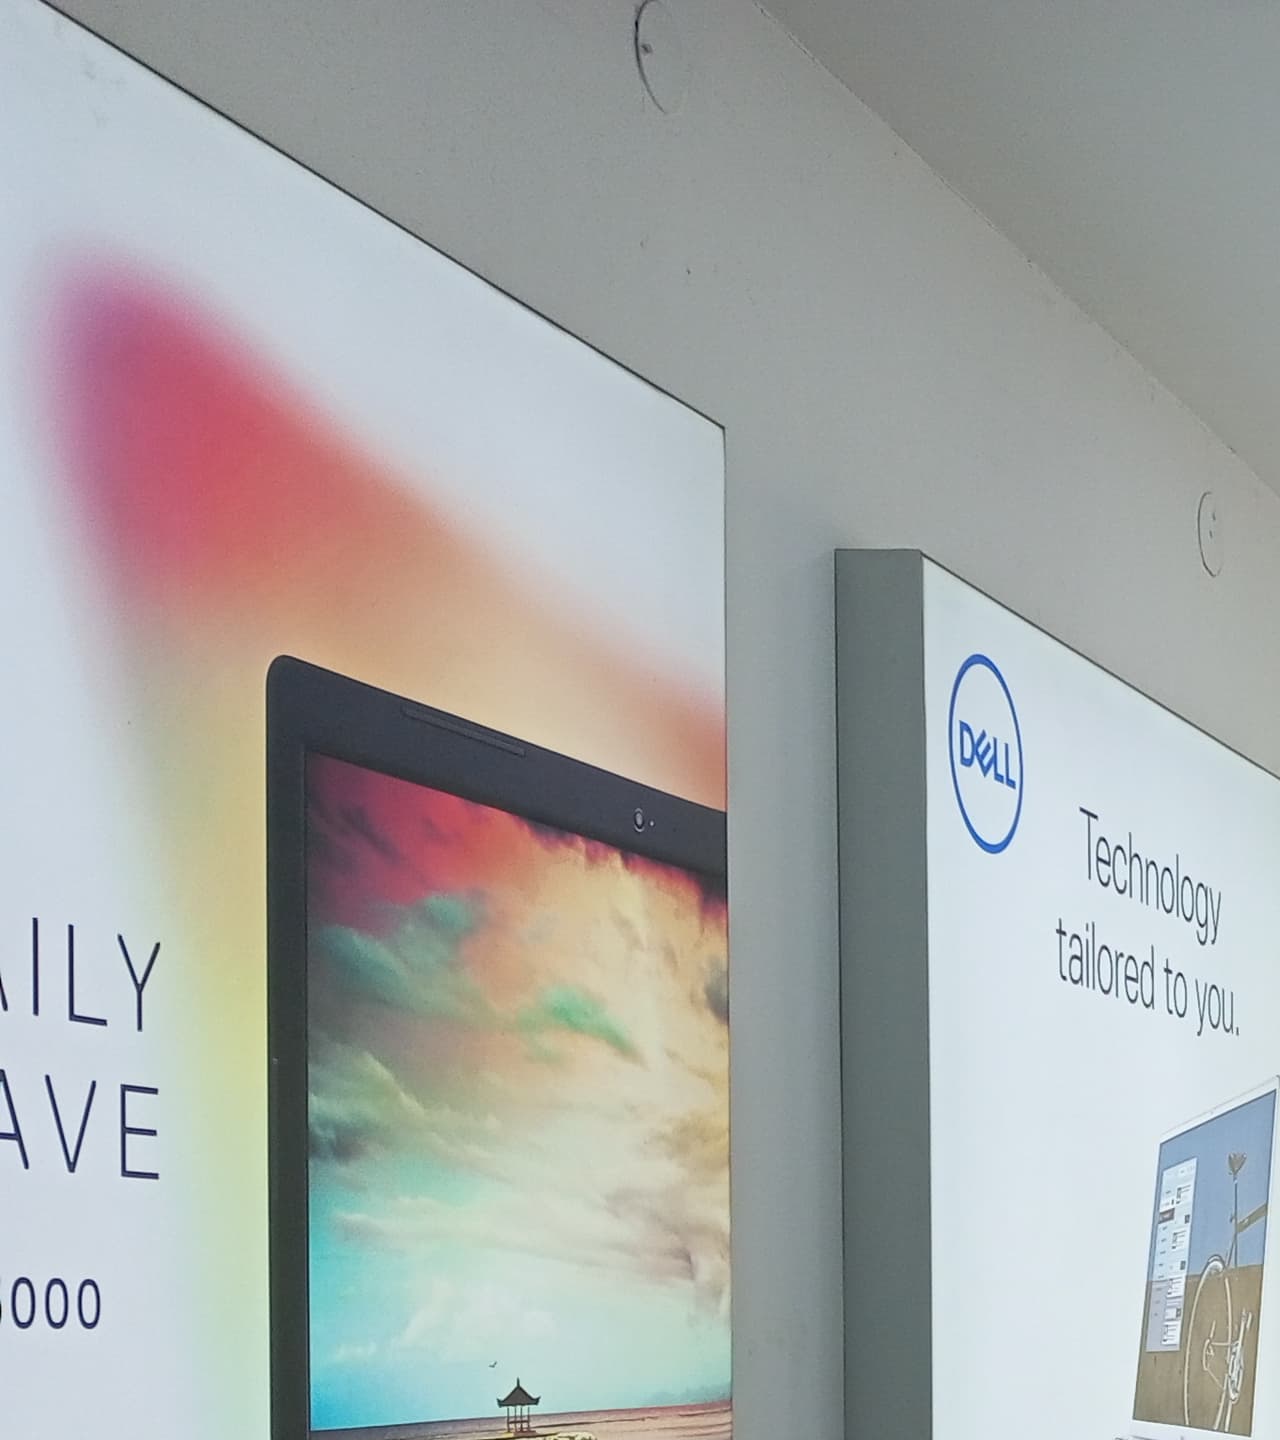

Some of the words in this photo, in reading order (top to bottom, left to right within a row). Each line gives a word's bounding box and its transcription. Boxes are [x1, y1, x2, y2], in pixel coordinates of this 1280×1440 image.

[959, 719, 1017, 790] DELL
[1079, 806, 1221, 945] Technology
[0, 917, 161, 1032] ILY
[1056, 917, 1154, 1010] tailored
[1163, 957, 1187, 1018] to
[1195, 977, 1239, 1037] you.
[0, 1277, 102, 1329] 000
